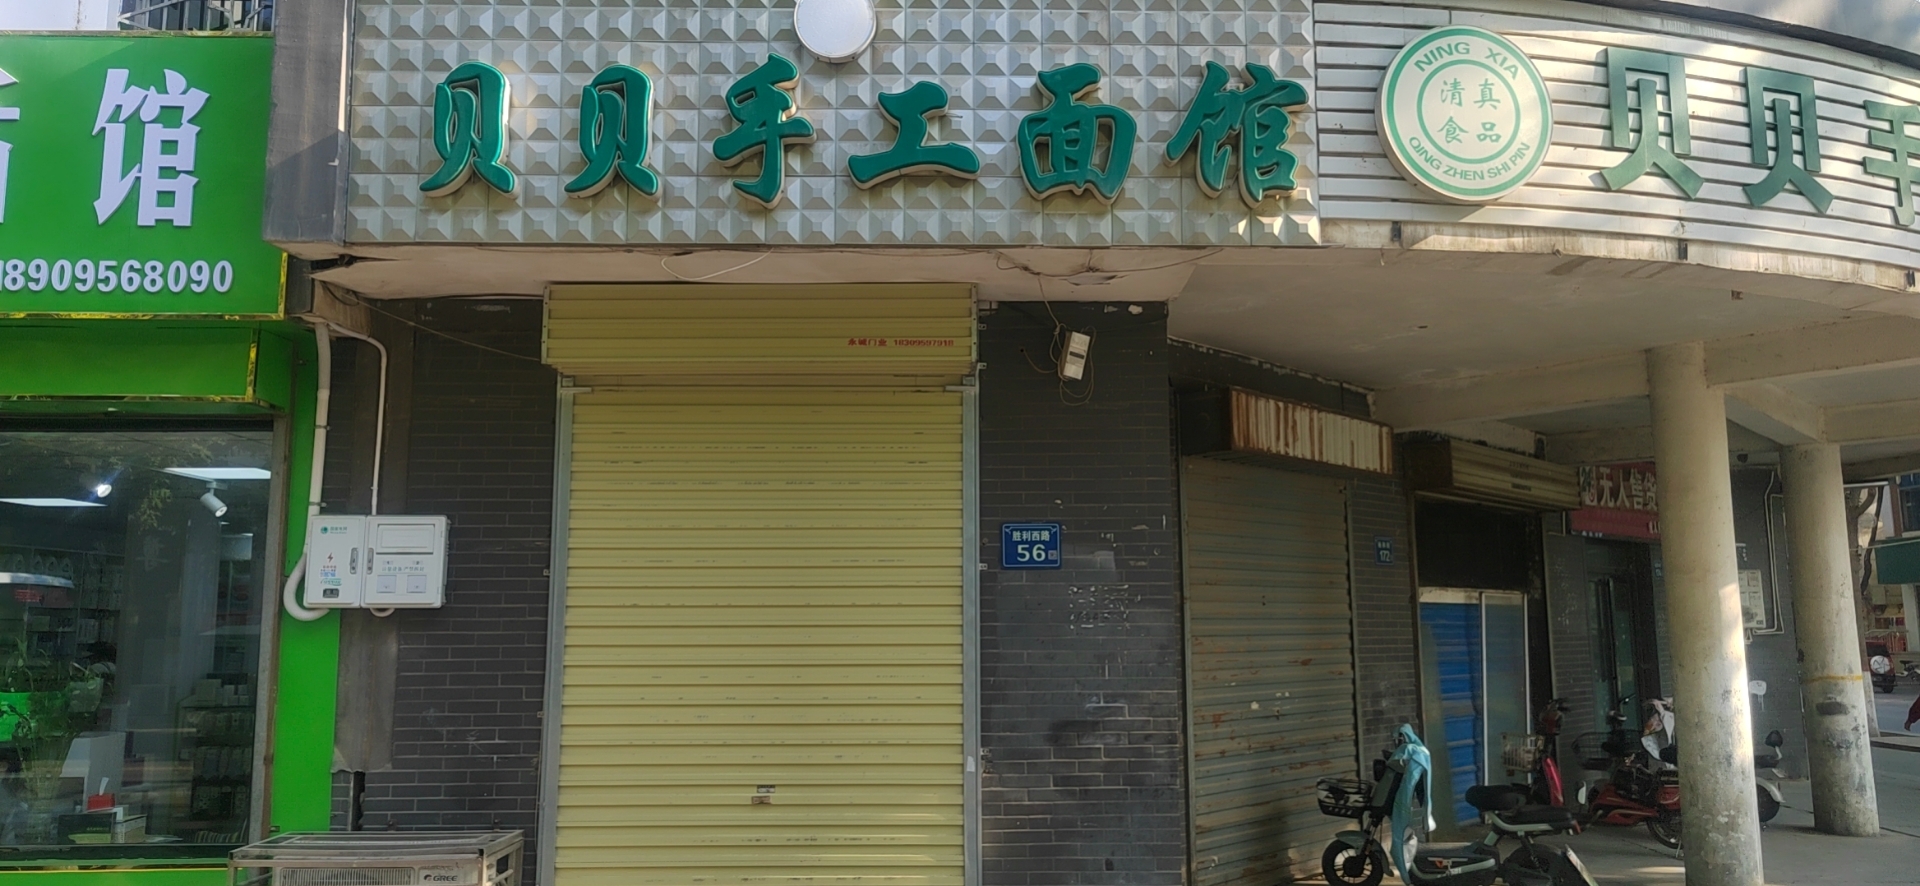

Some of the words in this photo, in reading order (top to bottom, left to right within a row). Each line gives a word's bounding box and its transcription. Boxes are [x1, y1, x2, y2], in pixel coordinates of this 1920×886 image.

[1413, 42, 1471, 73] NING
[1484, 47, 1520, 81] XIA
[1440, 78, 1501, 110] 清真
[419, 53, 1310, 208] 贝贝手工面馆
[1437, 116, 1502, 144] 食品
[1601, 47, 1920, 227] 贝贝手
[1408, 136, 1443, 171] QING
[1442, 164, 1485, 181] ZHEN
[1487, 159, 1512, 179] SHI
[1508, 141, 1531, 167] PIN
[1599, 466, 1658, 511] 无人售货
[1012, 530, 1050, 541] 胜利西路
[1017, 544, 1046, 562] 56
